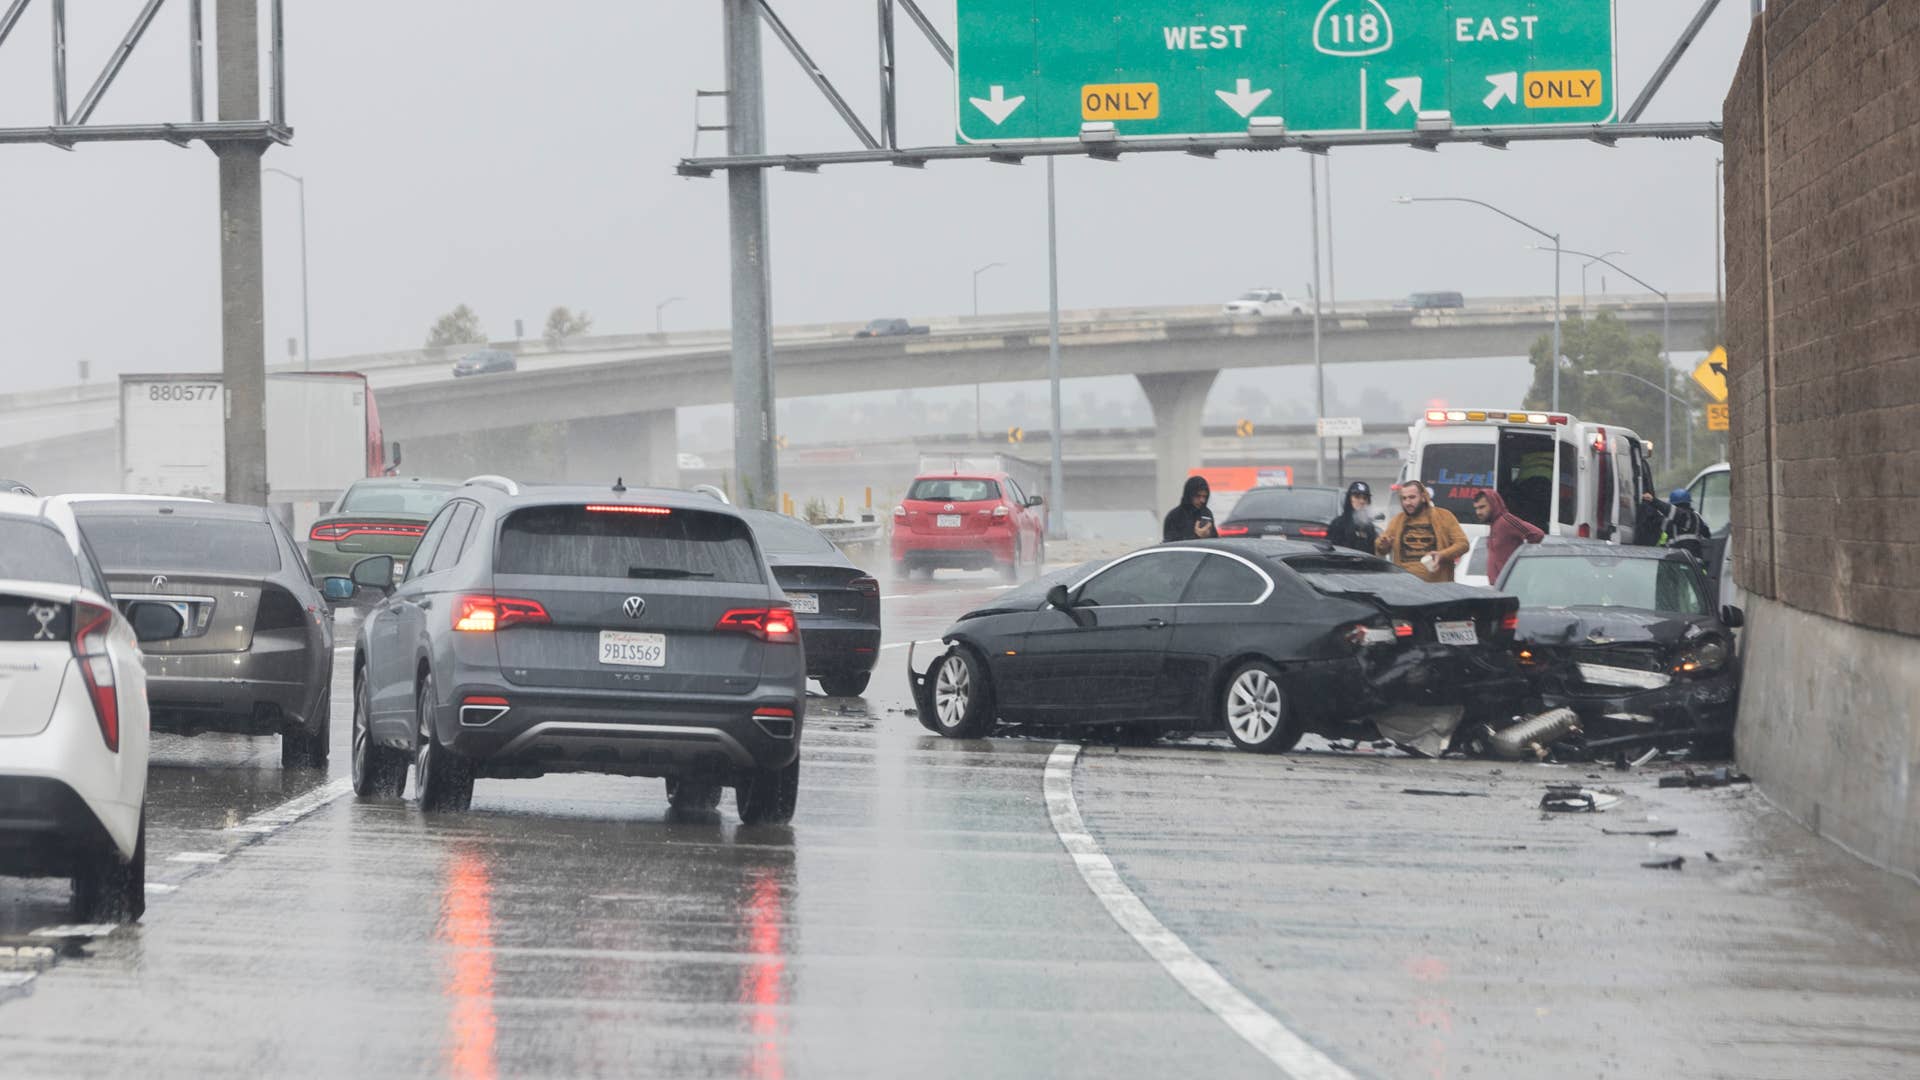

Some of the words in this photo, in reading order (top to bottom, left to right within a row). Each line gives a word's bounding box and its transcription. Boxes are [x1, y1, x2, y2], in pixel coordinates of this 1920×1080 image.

[1163, 24, 1247, 50] WEST
[1329, 13, 1379, 43] 118
[1456, 16, 1538, 41] EAST
[1529, 79, 1596, 99] ONLY
[1086, 91, 1152, 111] ONLY
[149, 385, 217, 400] 880577
[604, 643, 661, 661] 9BIS569
[615, 673, 651, 681] TAOS
